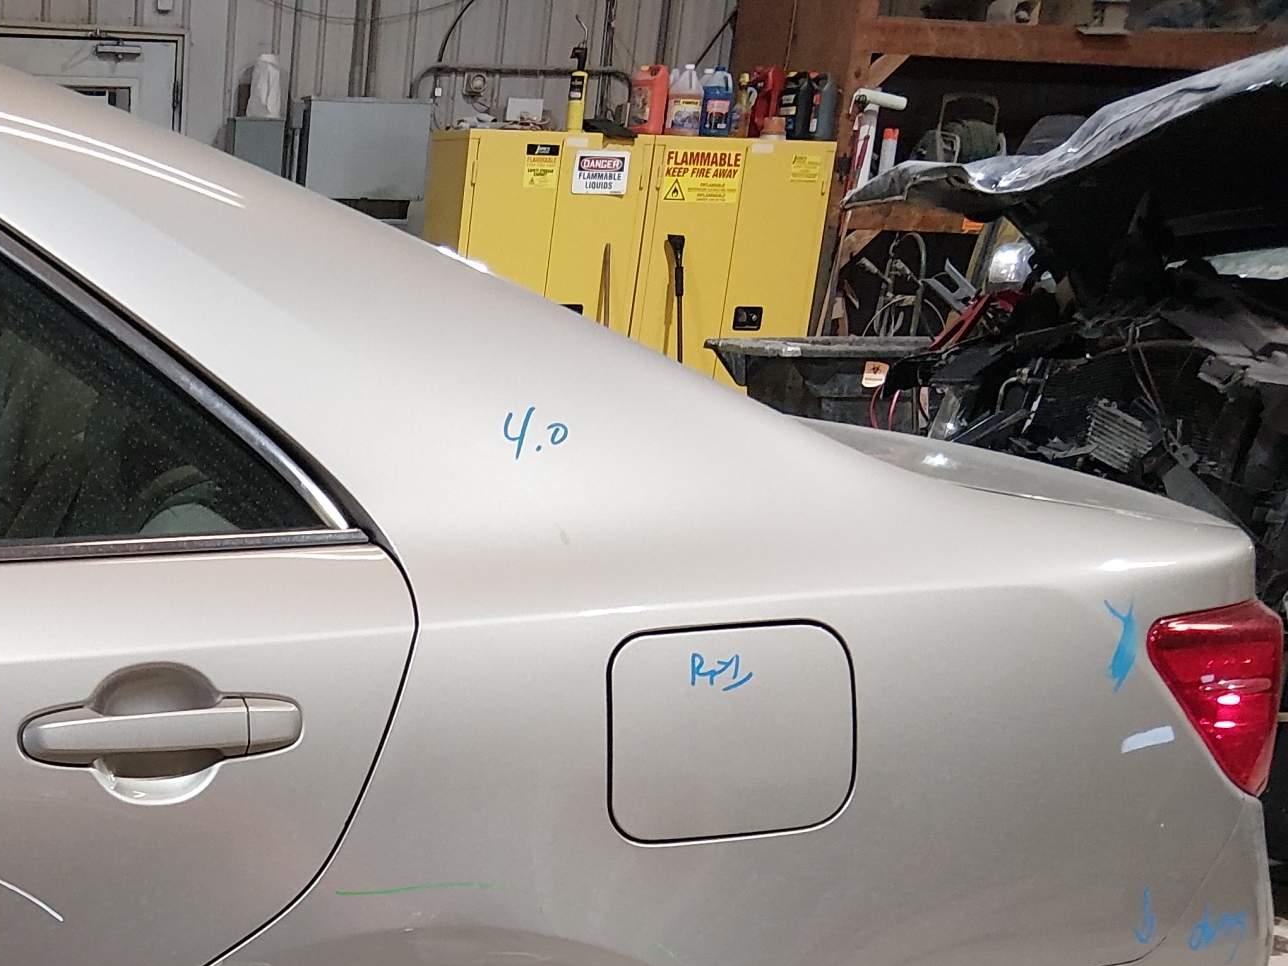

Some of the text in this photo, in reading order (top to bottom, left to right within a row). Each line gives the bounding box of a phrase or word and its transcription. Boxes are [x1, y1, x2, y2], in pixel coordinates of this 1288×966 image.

[583, 160, 620, 170] DANGER
[666, 151, 742, 168] FLAMMABLE
[578, 172, 622, 181] FLAMMABLE
[665, 166, 739, 179] KEEP FIRE AWAY
[585, 181, 613, 190] LIQUIDS
[503, 406, 569, 460] 4.0
